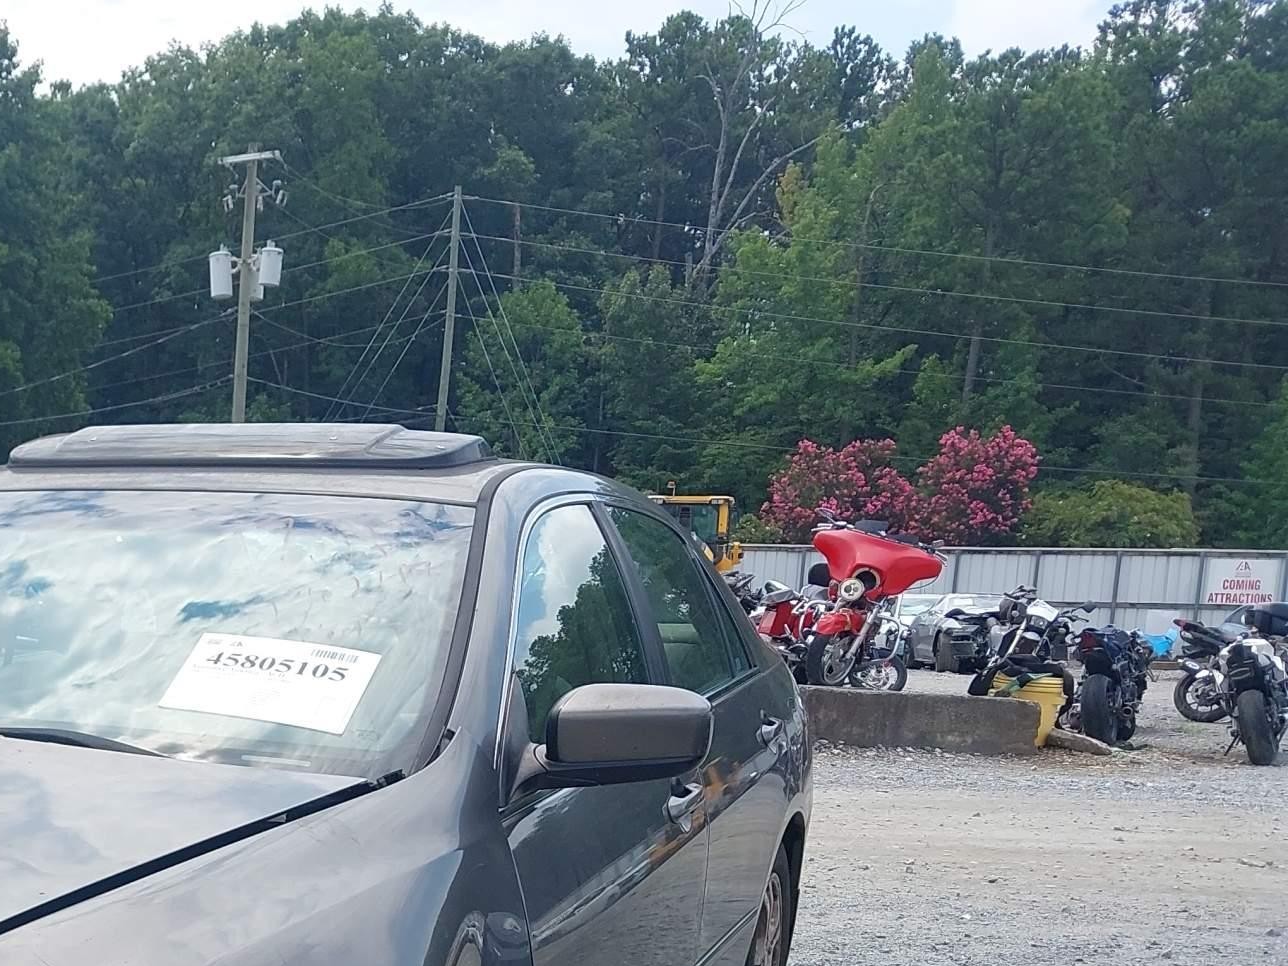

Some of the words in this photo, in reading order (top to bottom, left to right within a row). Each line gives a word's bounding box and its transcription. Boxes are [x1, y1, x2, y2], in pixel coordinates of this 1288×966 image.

[1222, 579, 1261, 590] COMING
[1207, 592, 1273, 604] ATTRACTIONS
[206, 651, 350, 682] 45805105
